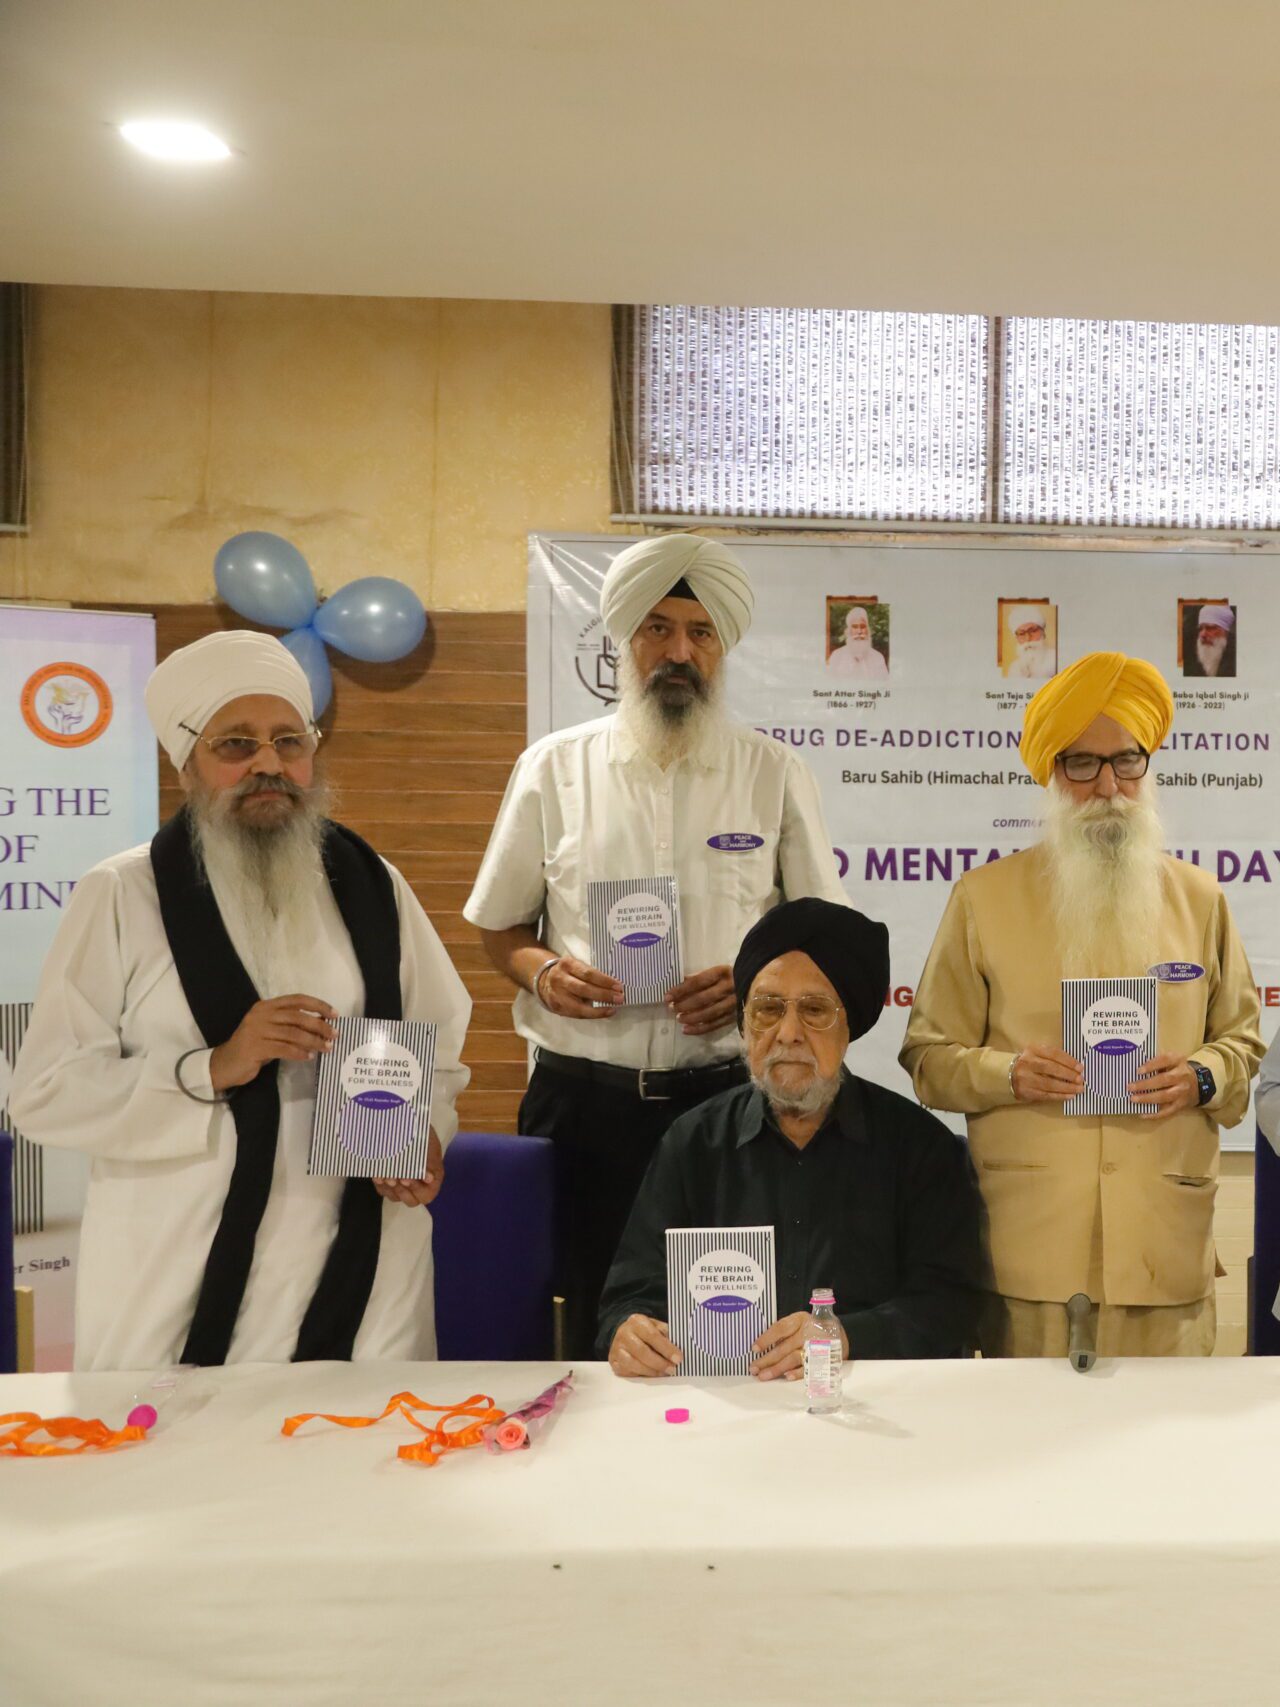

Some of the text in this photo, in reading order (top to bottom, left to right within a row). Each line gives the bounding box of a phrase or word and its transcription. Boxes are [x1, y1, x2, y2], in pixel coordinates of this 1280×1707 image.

[858, 690, 882, 699] Singh
[1007, 692, 1024, 700] Teja
[1196, 691, 1217, 700] Iqbal
[1219, 691, 1242, 701] Singh
[856, 700, 876, 709] 1927)
[1176, 702, 1196, 710] (1926
[1203, 701, 1225, 710] 2022)
[836, 729, 1022, 748] DE-ADDICTION
[842, 770, 876, 784] Baru
[881, 771, 923, 785] Sahib
[927, 771, 1004, 786] (Himachal
[1157, 773, 1263, 790] Sahib (Punjab)
[26, 788, 111, 816] THE
[617, 905, 661, 915] REWIRING
[616, 914, 662, 923] THE BRAIN
[629, 921, 666, 929] WELLNESS
[356, 1057, 409, 1068] REWIRING
[353, 1067, 411, 1078] THE BRAIN
[348, 1076, 413, 1087] FOR WELLNESS
[29, 1256, 70, 1272] Singh
[700, 1265, 752, 1273] REWIRING
[698, 1275, 719, 1283] THE
